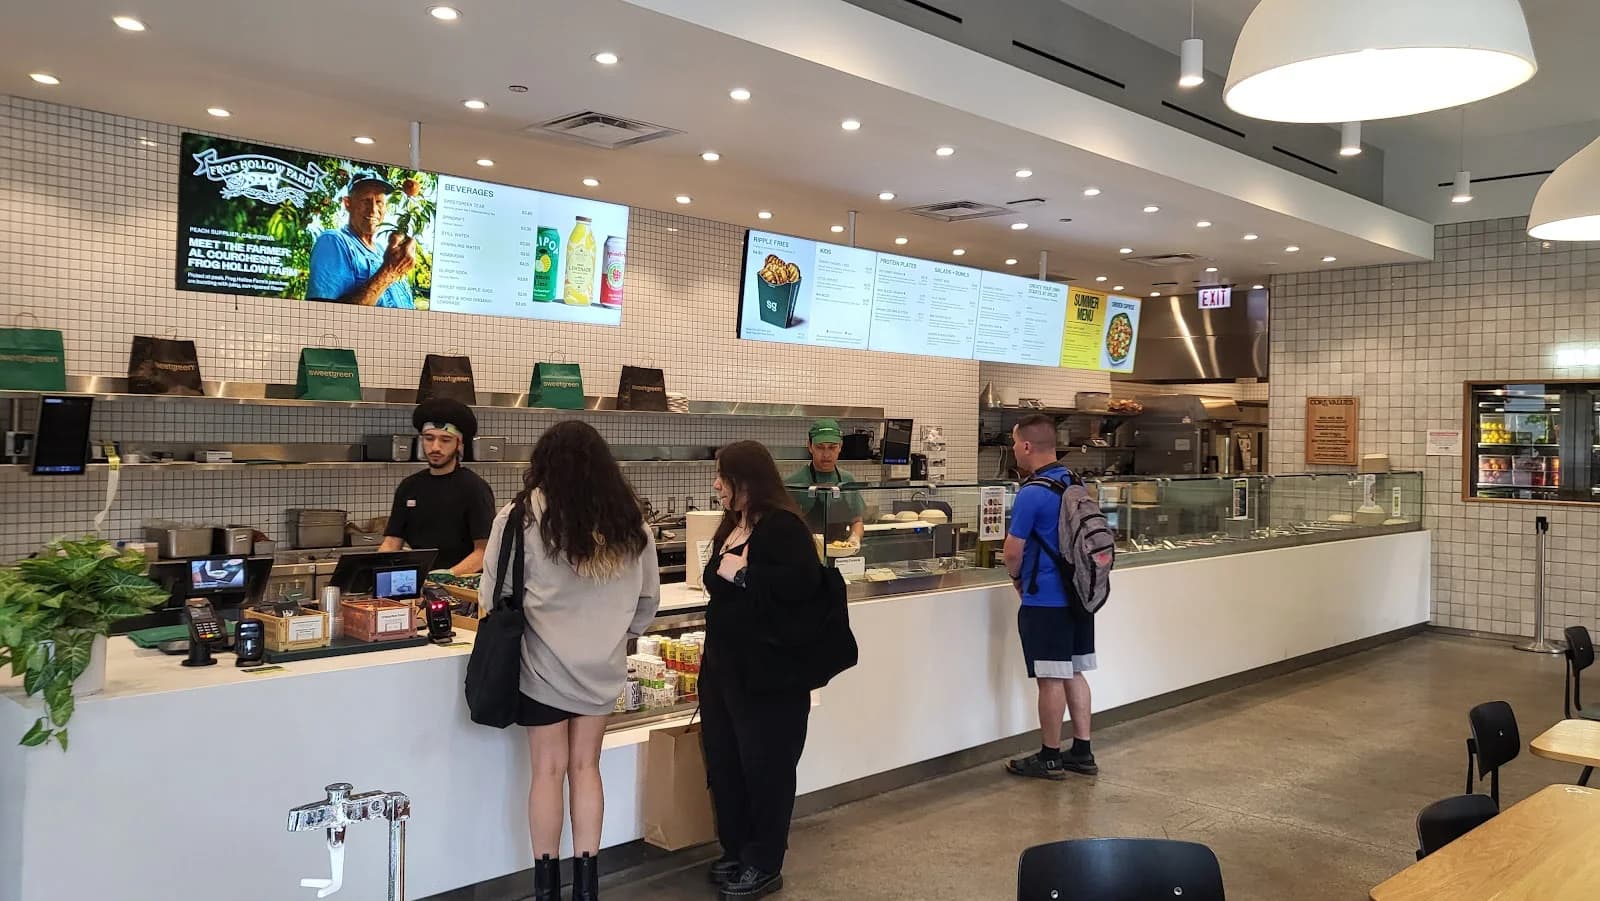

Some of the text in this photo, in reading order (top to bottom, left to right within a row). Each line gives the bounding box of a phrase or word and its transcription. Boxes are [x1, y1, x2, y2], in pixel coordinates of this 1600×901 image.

[209, 160, 314, 188] FROG HOLLOW FARM
[444, 183, 494, 198] BEVERAGES
[190, 226, 210, 234] PEACH
[188, 237, 221, 249] MEET
[223, 241, 246, 252] THE
[753, 236, 789, 248] RIPPLE FRIES
[188, 248, 283, 267] AL COURCHESNE,
[187, 258, 299, 277] FROG HOLLOW FARM
[900, 261, 917, 269] PLATES
[1074, 293, 1099, 309] SUMMER
[1202, 290, 1227, 306] EXIT
[766, 299, 777, 312] sg
[1077, 308, 1095, 322] MENU
[308, 368, 354, 379] sweetgreen
[432, 374, 470, 383] sweetgreen
[543, 381, 579, 389] sweetgreen
